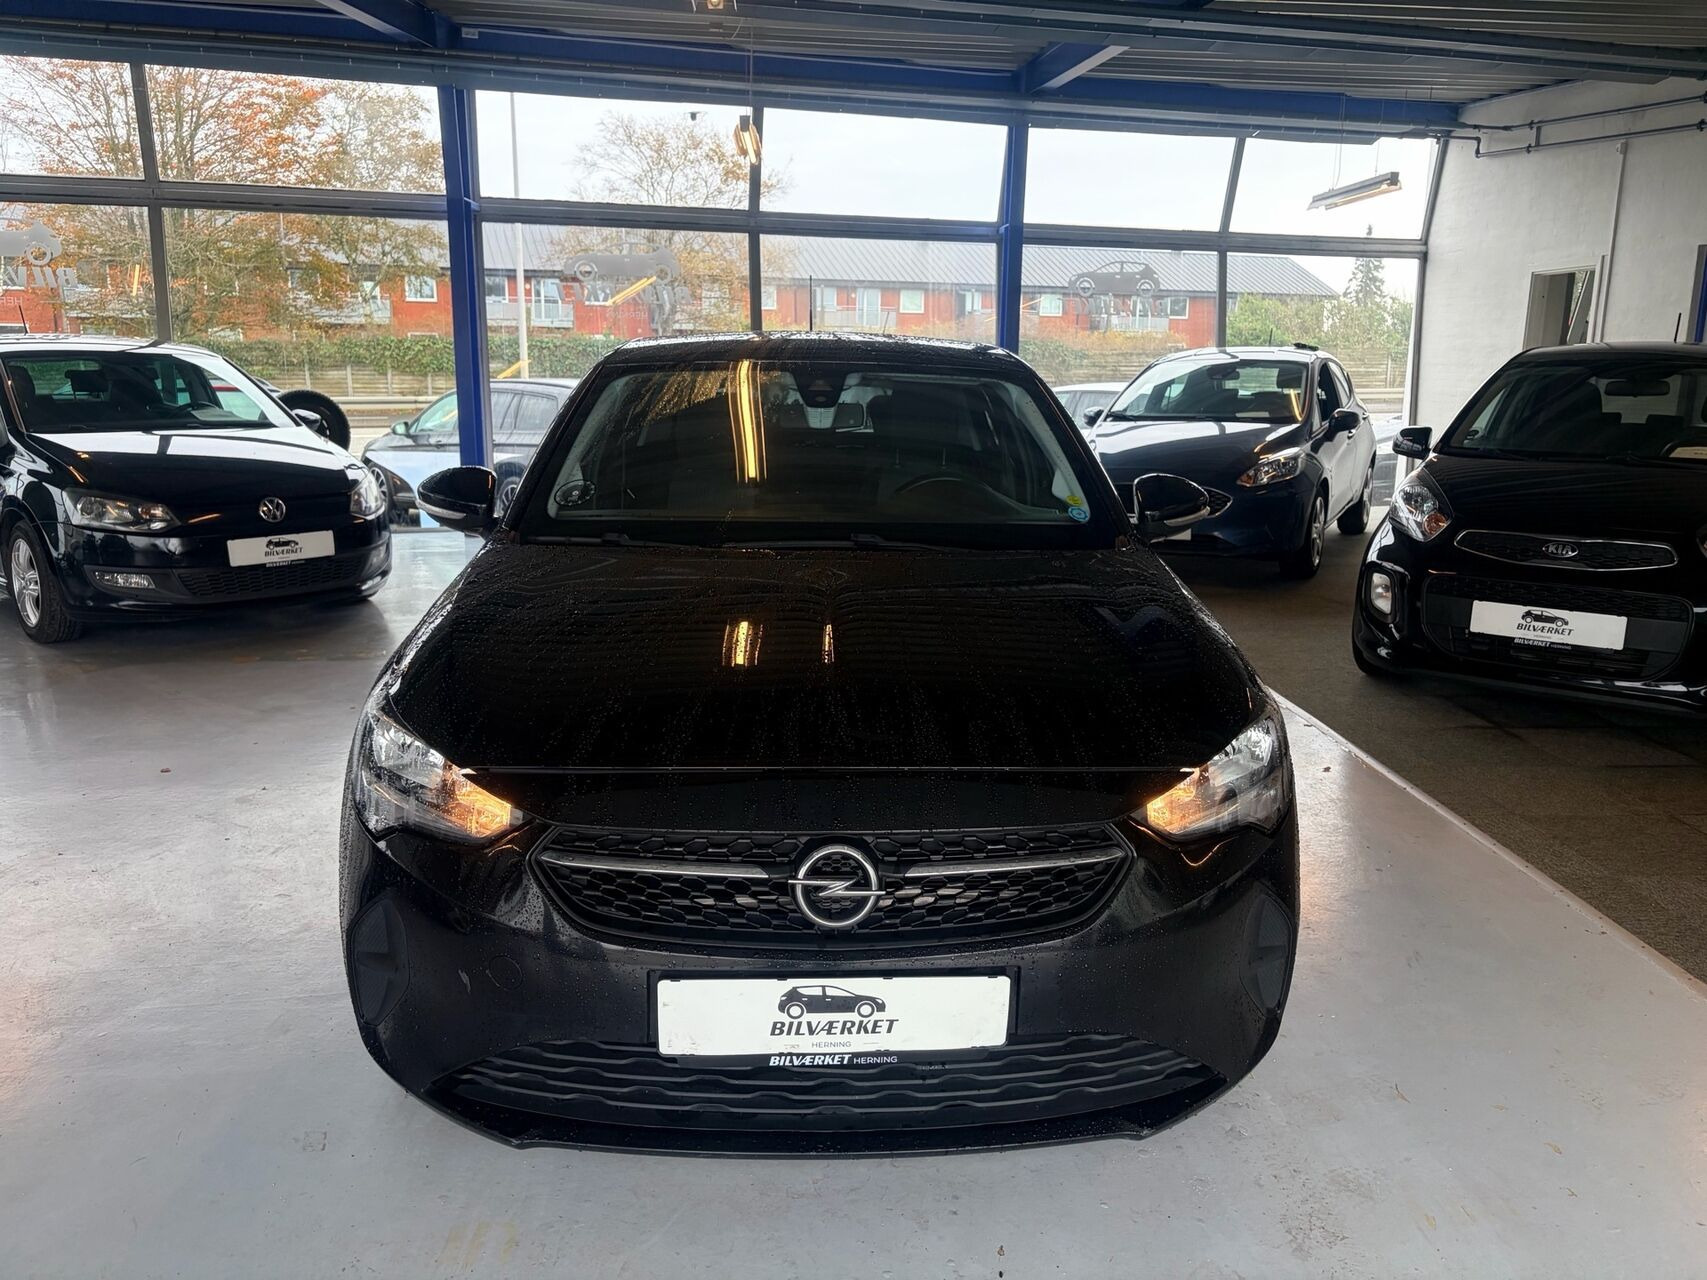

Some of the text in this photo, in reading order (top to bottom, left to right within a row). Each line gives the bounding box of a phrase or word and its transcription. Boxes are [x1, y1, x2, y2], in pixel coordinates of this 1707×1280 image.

[1548, 544, 1572, 555] KIA
[1516, 622, 1574, 636] BILVÆRKET
[770, 1019, 899, 1036] BILVÆRKET
[811, 1041, 852, 1049] HERNING
[769, 1054, 898, 1066] BILVÆRKET HERNING
